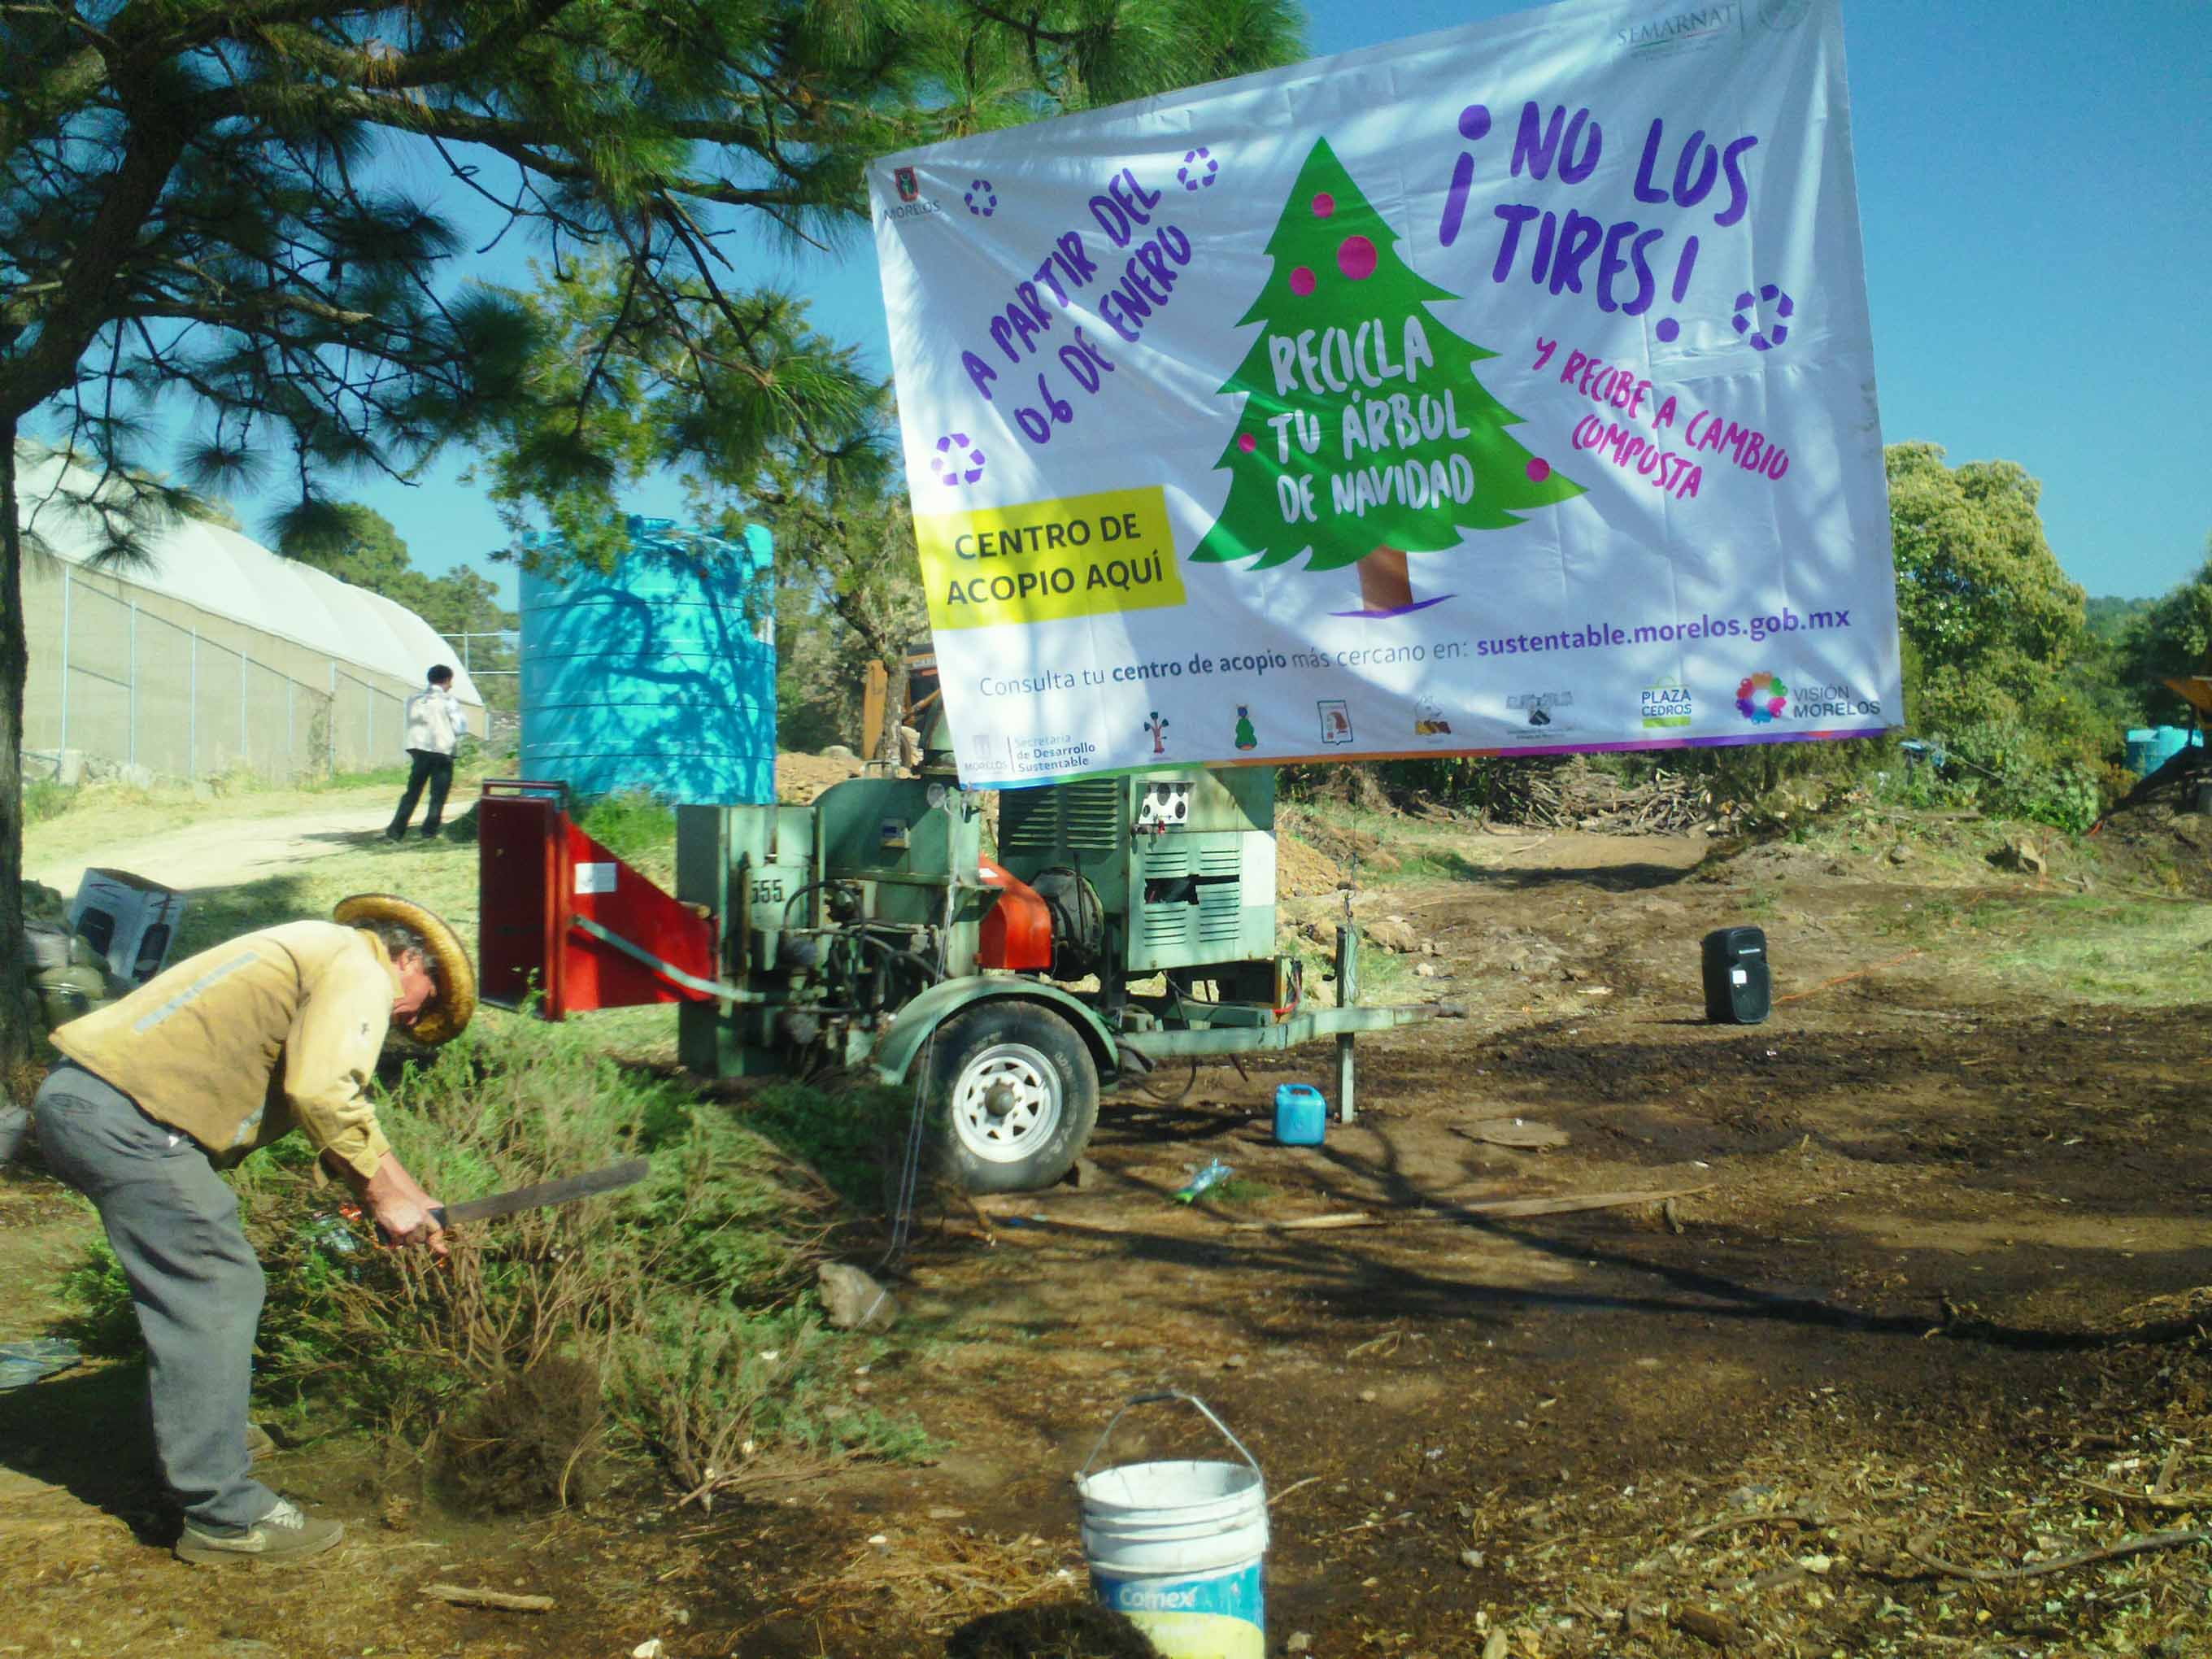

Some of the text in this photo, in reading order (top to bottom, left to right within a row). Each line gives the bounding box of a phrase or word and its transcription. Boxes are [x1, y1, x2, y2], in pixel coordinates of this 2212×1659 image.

[1633, 117, 1758, 228] LOS
[961, 168, 1161, 401] A PARTIR DEL
[1014, 225, 1191, 444] 06 DE ENERO
[1269, 315, 1434, 396] RECICLA
[1267, 389, 1471, 464] TU ÁRBOL
[1532, 337, 1789, 481] Y RECIBE A CAMBIO
[1277, 454, 1475, 523] DE NAVIDAD
[1572, 415, 1702, 499] COMPOSTA
[955, 513, 1141, 560] CENTRO DE
[947, 549, 1163, 605] ACOPIO AQUÍ
[980, 607, 1850, 696] Consulta tu centro de acopio más cercano en: sustentable.morelos.gob.mx
[1641, 689, 1692, 703] PLAZA
[1641, 703, 1692, 716] CEDROS
[1793, 684, 1849, 702] VISIÓN
[1793, 700, 1881, 718] MORELOS
[1018, 756, 1089, 773] Sustentable
[1033, 742, 1095, 759] Desarrollo
